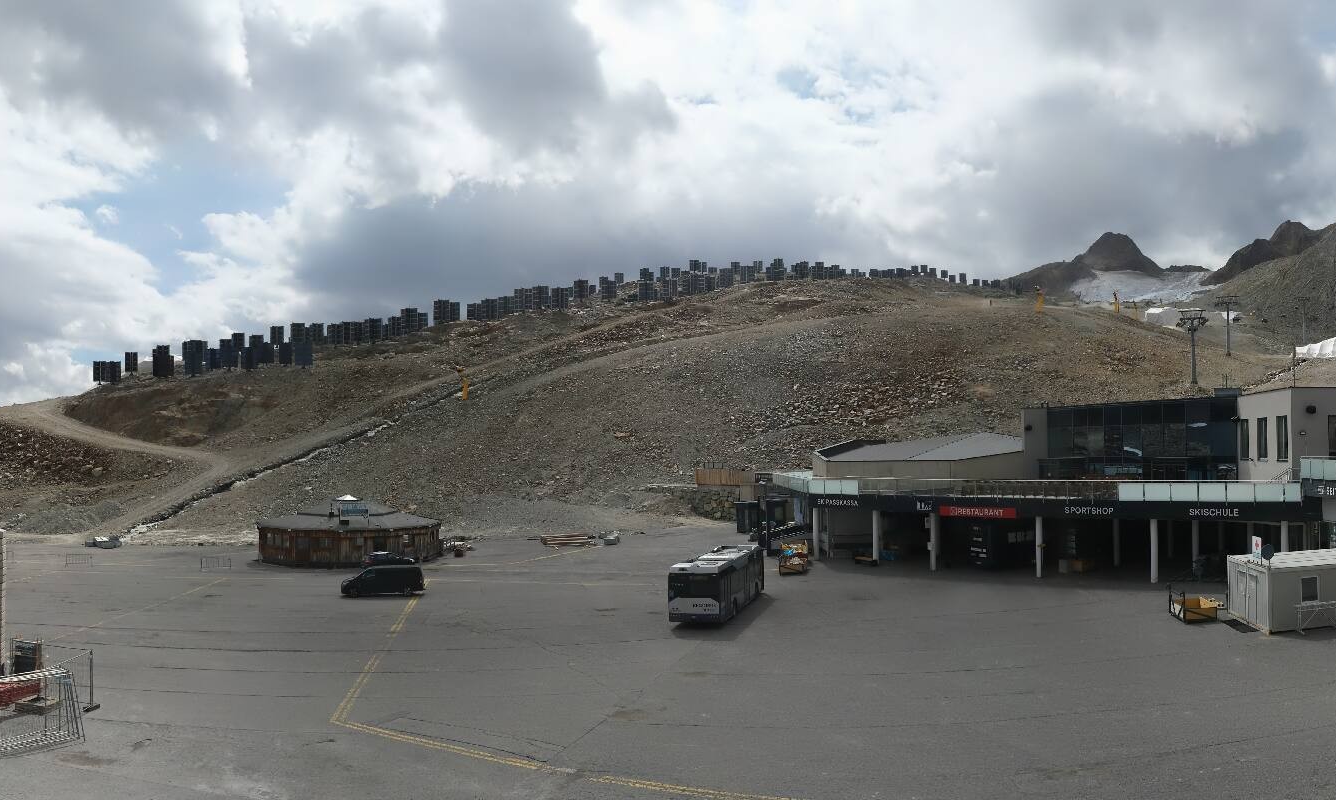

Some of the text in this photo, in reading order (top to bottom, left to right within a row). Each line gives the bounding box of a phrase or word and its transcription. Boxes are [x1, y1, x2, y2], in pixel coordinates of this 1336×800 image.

[957, 508, 1004, 517] RESTAURANT
[1064, 506, 1114, 515] SPORTSHOP
[1189, 508, 1239, 517] SKISCHULE
